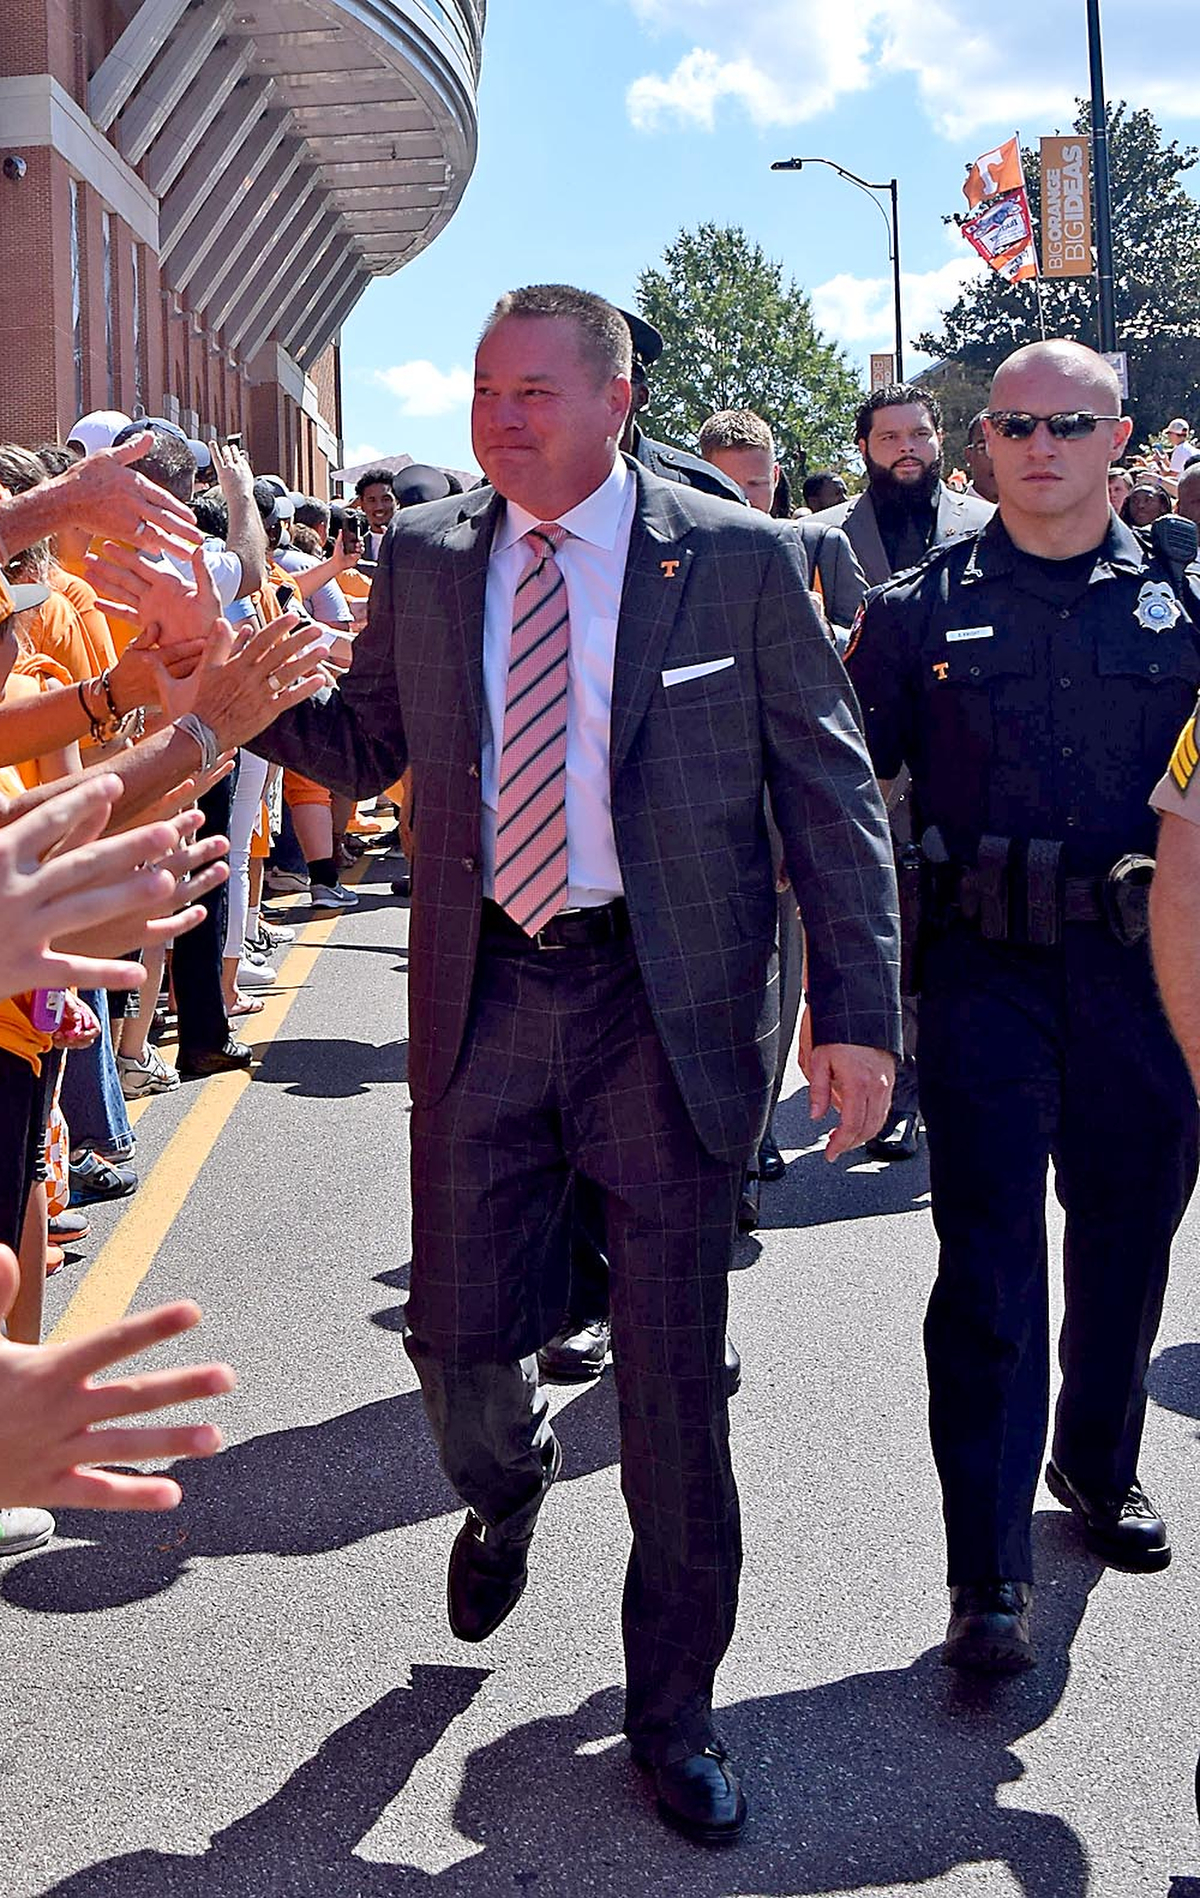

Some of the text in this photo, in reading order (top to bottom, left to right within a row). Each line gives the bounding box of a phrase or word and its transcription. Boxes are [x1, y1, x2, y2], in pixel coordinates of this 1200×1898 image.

[976, 149, 1004, 195] T
[660, 560, 680, 577] T
[932, 661, 949, 680] T
